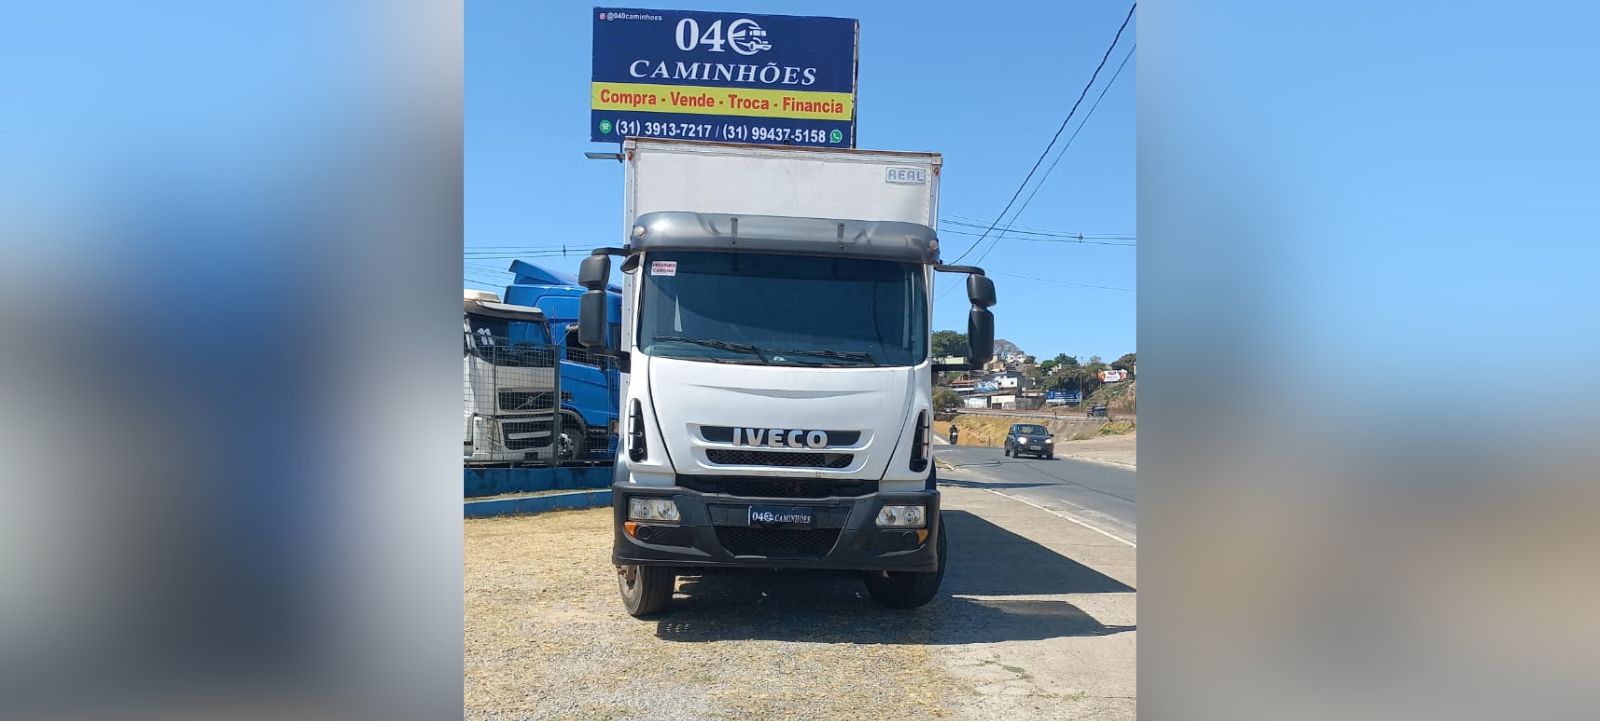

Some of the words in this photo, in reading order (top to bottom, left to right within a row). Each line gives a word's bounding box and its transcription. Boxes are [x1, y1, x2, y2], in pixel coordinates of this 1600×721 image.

[607, 12, 662, 21] @040caminhoes
[629, 59, 817, 86] CAMINHÕES
[600, 89, 657, 107] Compra
[670, 91, 715, 107] Vende
[728, 94, 770, 110] Troca
[782, 97, 844, 114] Financia
[615, 119, 641, 136] (31)
[645, 122, 712, 138] 3913-7217
[722, 124, 748, 141] (31)
[751, 126, 826, 143] 99437-5158
[888, 169, 924, 181] REAL
[733, 427, 828, 448] IVECO
